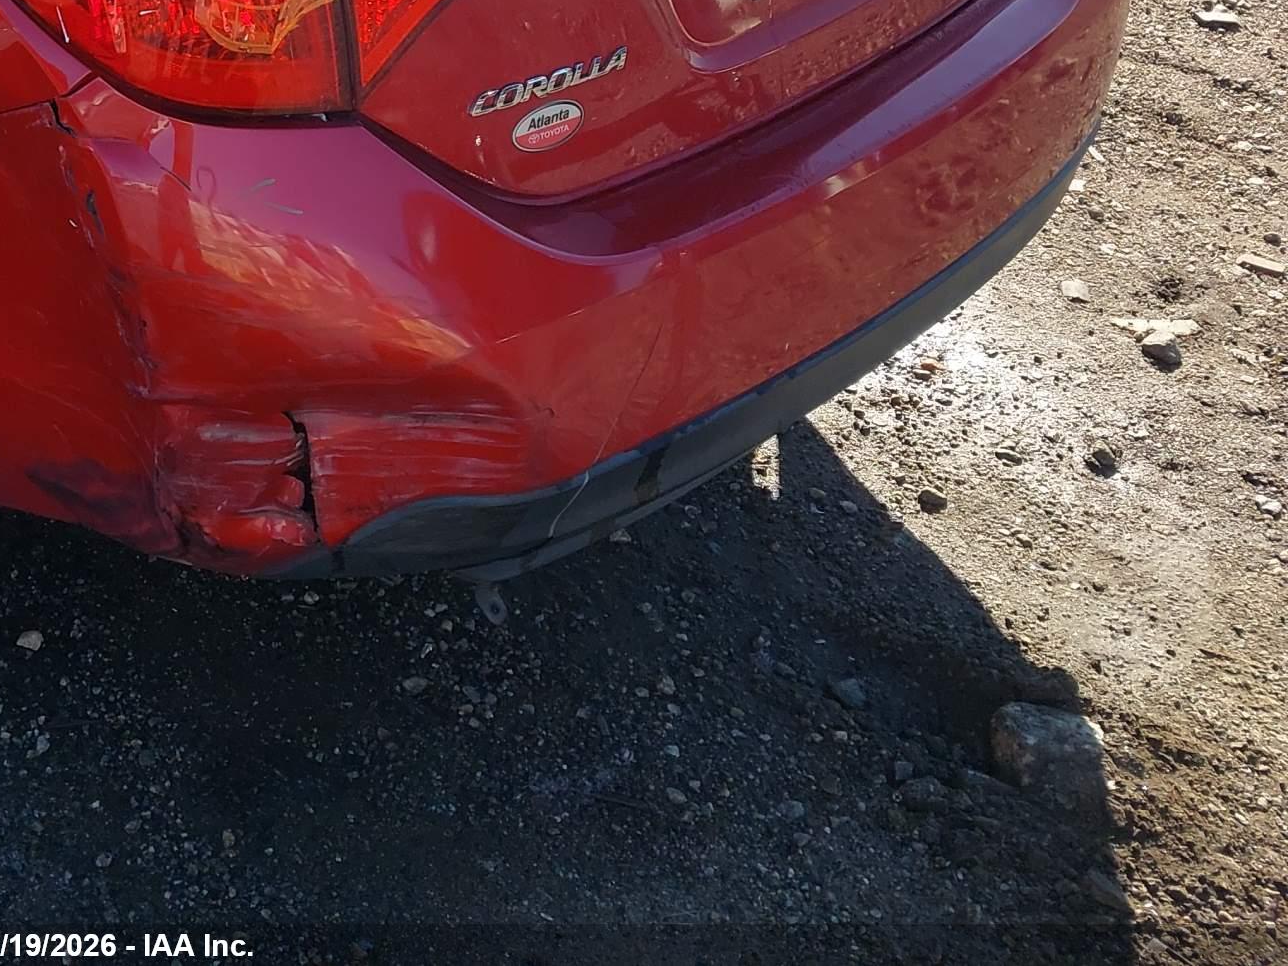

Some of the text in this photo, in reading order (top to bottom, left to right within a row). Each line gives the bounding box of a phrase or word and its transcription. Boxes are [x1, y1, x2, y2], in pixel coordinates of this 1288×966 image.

[467, 45, 627, 117] COROLLA
[527, 108, 570, 132] Atlanta
[538, 124, 570, 140] TOYOTA
